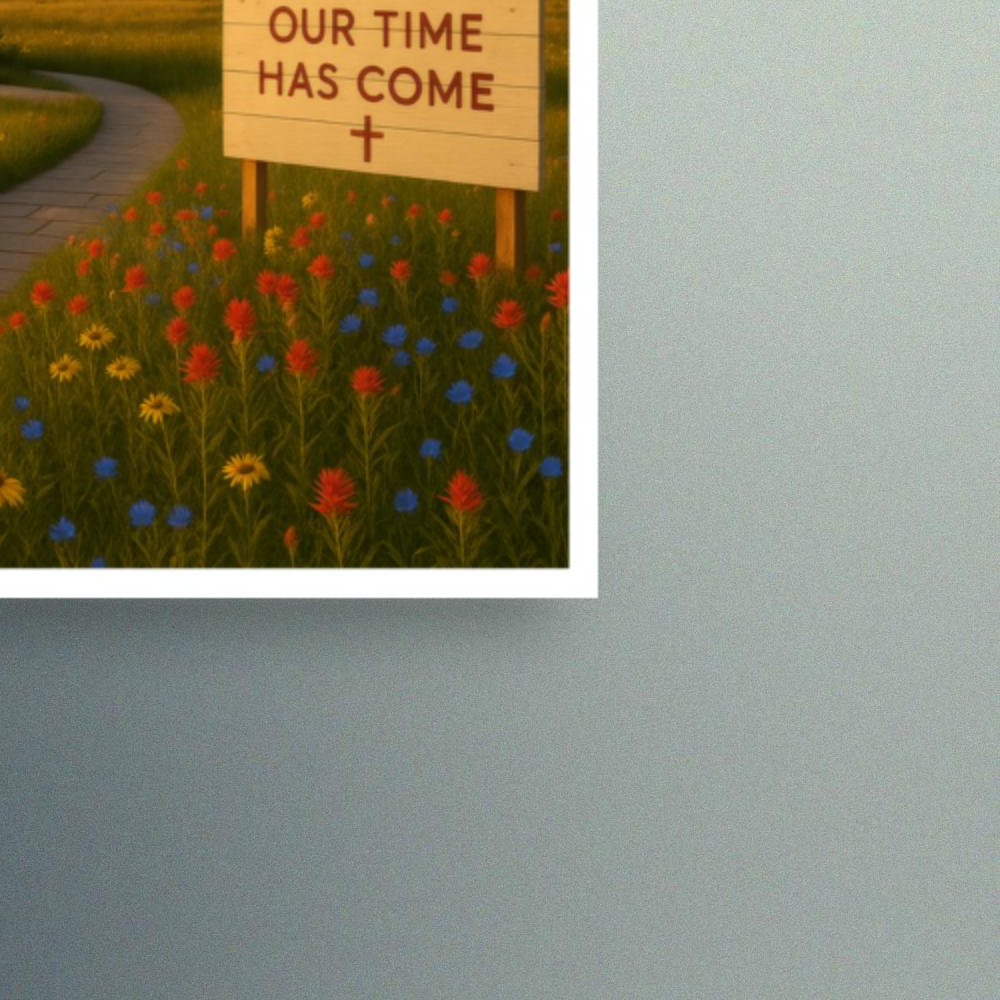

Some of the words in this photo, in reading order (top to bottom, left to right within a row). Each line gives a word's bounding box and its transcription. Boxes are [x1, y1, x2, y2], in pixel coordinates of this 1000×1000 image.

[269, 6, 355, 46] OUR
[373, 10, 483, 52] TIME
[259, 60, 339, 100] HAS
[357, 65, 495, 112] COME
